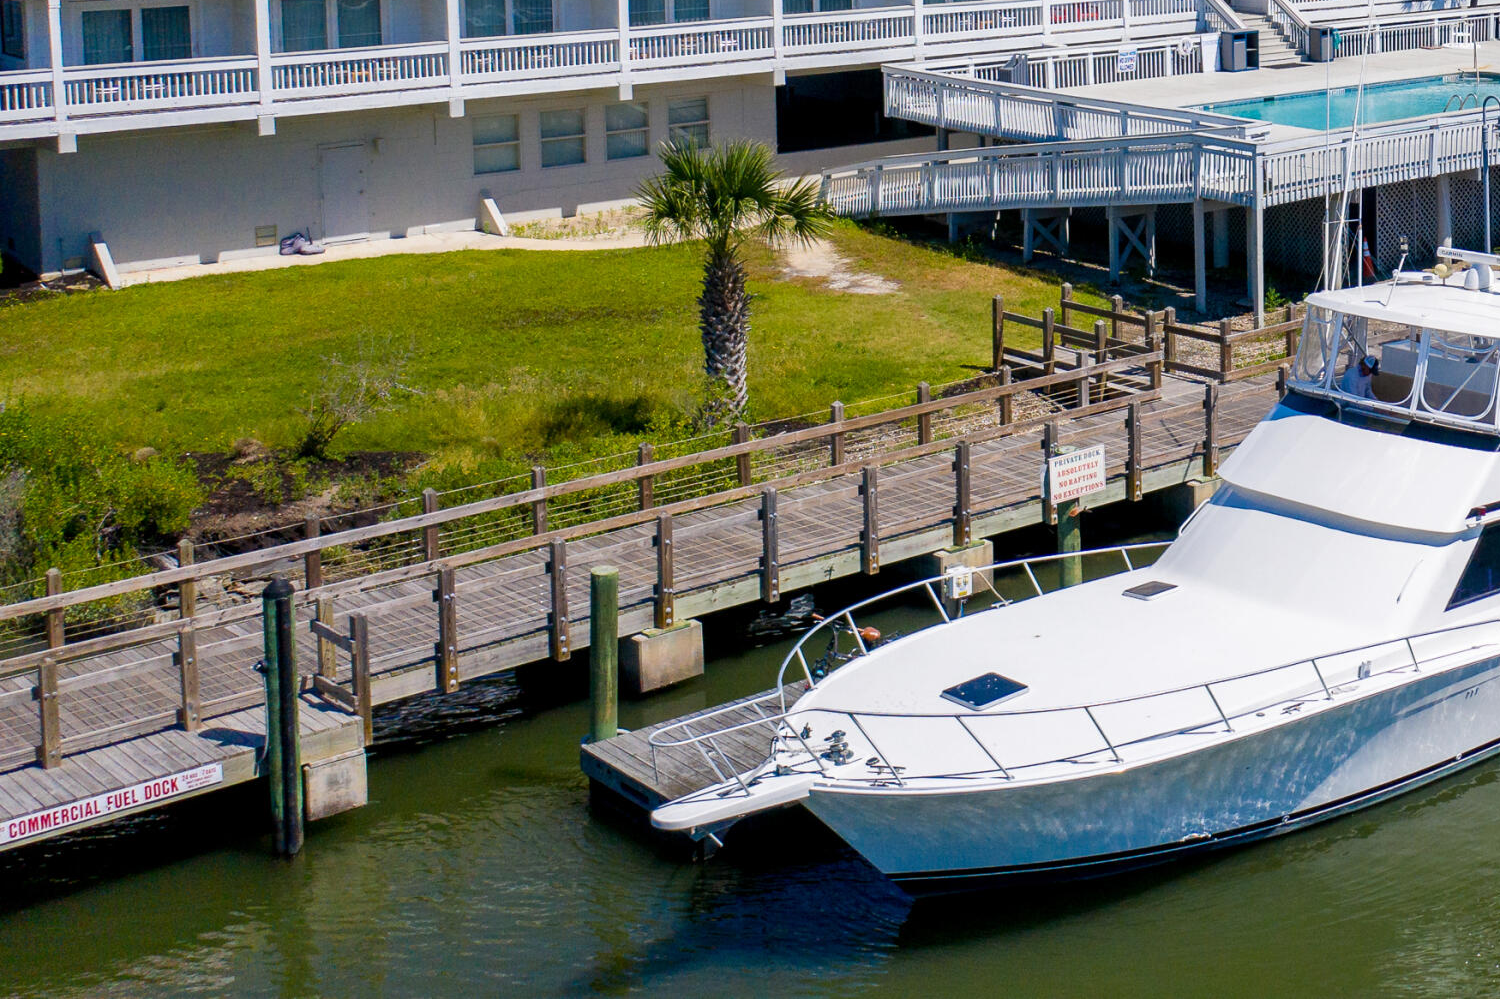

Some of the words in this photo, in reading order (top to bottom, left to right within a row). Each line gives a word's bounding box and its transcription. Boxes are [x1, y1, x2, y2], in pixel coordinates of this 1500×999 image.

[1054, 454, 1081, 468] PRIVATE
[1083, 449, 1101, 460] DOCK
[1057, 461, 1099, 477] ABSOLUTELY
[1069, 472, 1098, 484] RAFTING
[1063, 481, 1104, 498] EXCEPTIONS
[9, 800, 101, 838] COMMERCIAL
[107, 791, 139, 811] FUEL
[144, 777, 180, 800] DOCK
